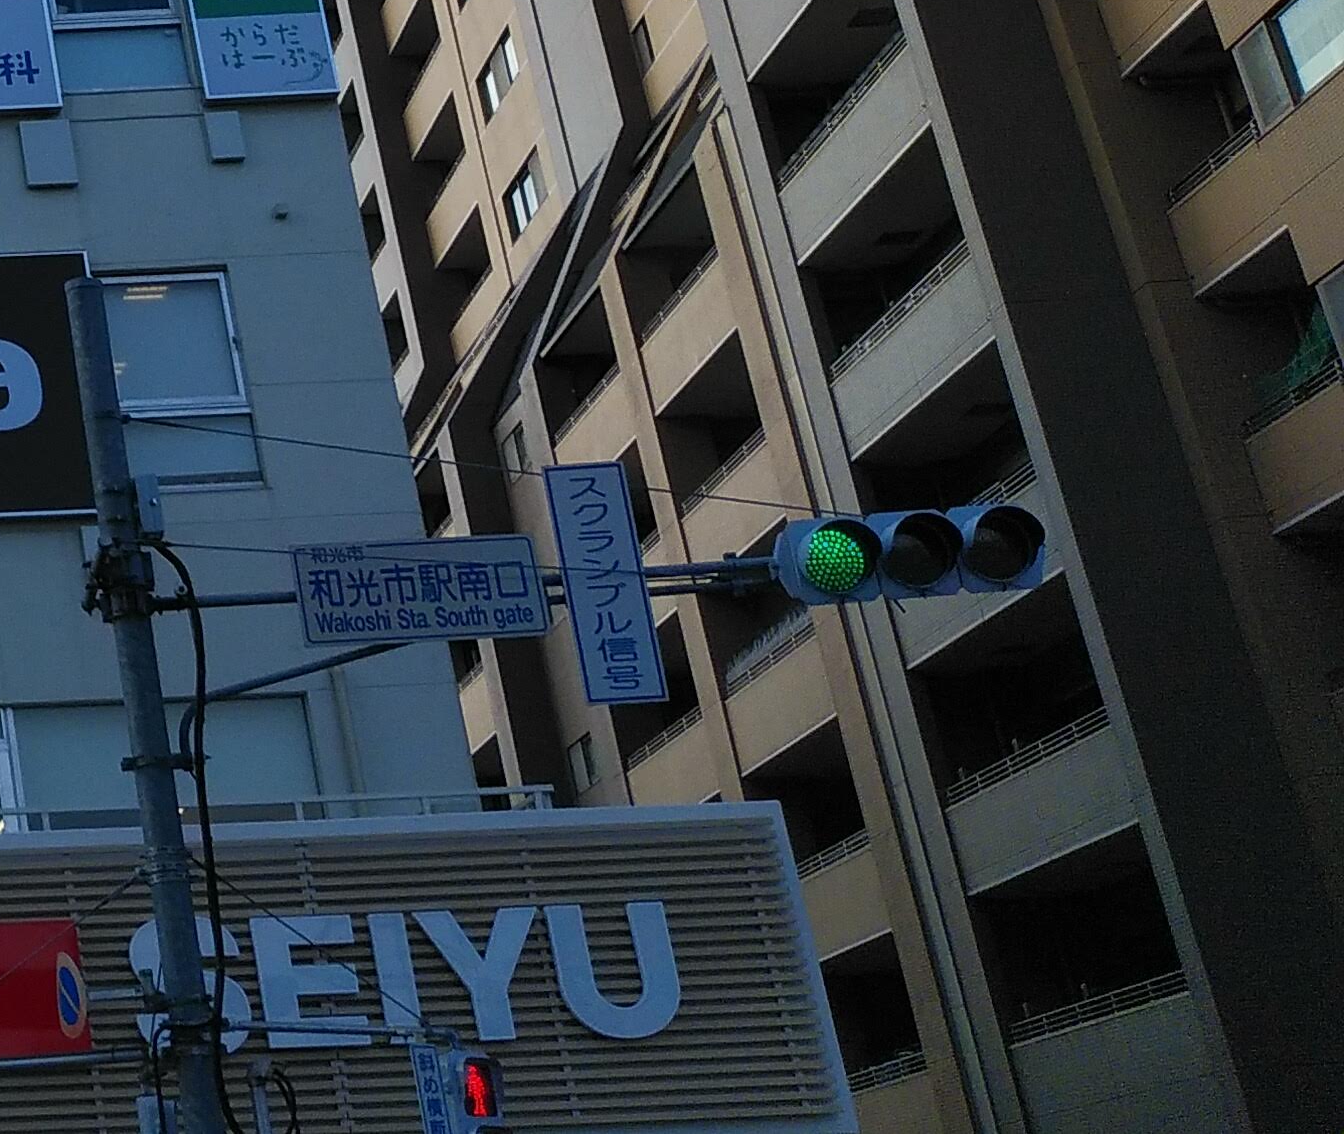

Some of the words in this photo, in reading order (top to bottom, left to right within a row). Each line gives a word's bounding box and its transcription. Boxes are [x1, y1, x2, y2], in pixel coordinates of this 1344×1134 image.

[220, 22, 300, 47] からだ
[222, 46, 307, 70] はーぶ
[311, 546, 365, 563] 和光市
[308, 561, 529, 610] 和光市駅南口
[568, 475, 644, 691] スクランブル信号
[315, 608, 392, 635] Wakoshi
[436, 605, 488, 629] South
[494, 604, 534, 629] gate
